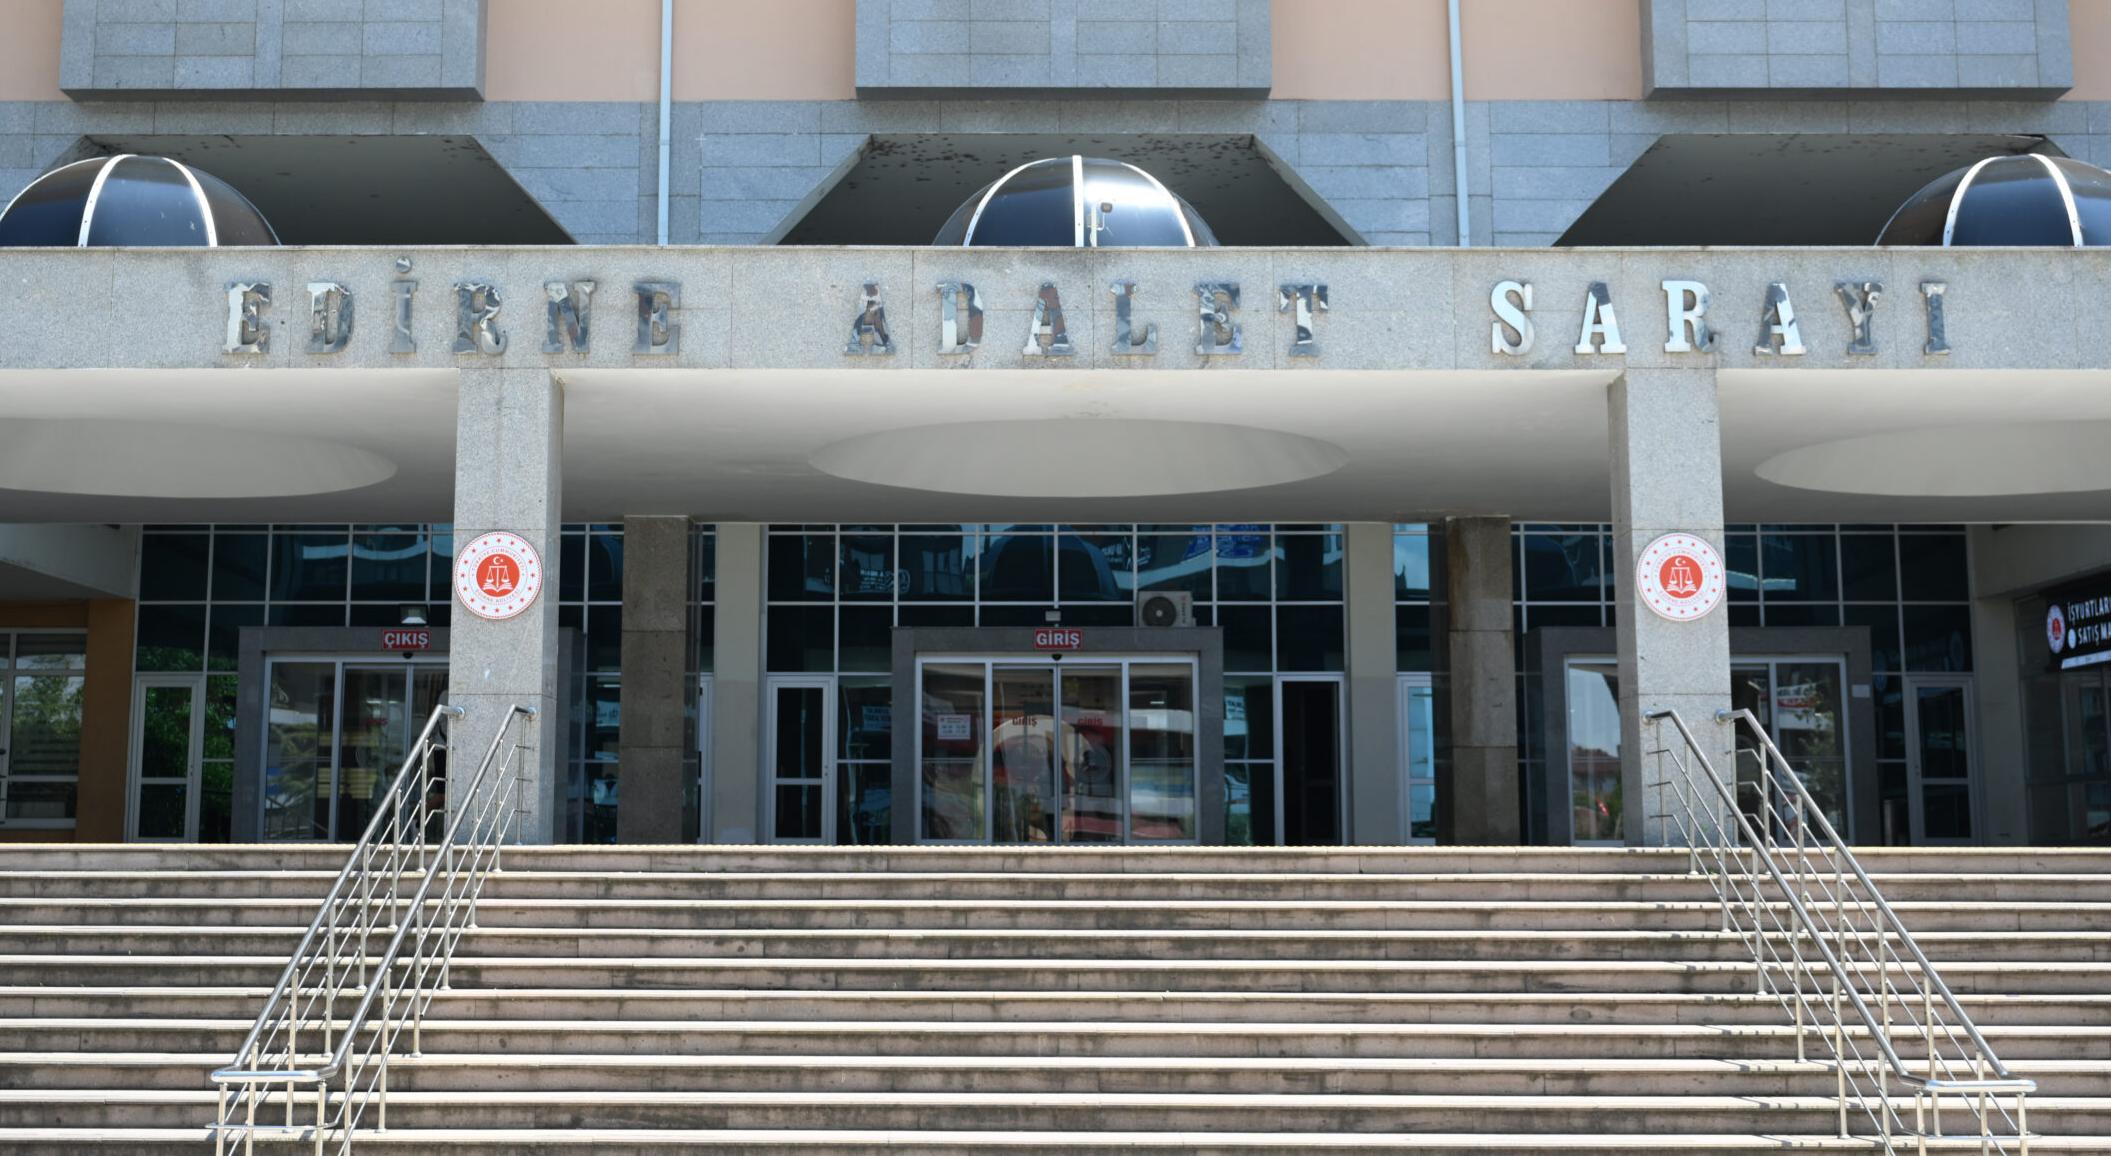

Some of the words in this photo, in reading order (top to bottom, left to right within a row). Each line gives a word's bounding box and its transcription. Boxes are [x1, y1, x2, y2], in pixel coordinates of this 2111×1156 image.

[221, 256, 683, 355] EDİRNE
[844, 281, 1329, 357] ADALET
[1490, 279, 1951, 356] SARAYI
[384, 632, 428, 649] ÇIKIŞ
[1036, 629, 1080, 649] GİRİŞ
[2078, 625, 2099, 646] SATIŞ
